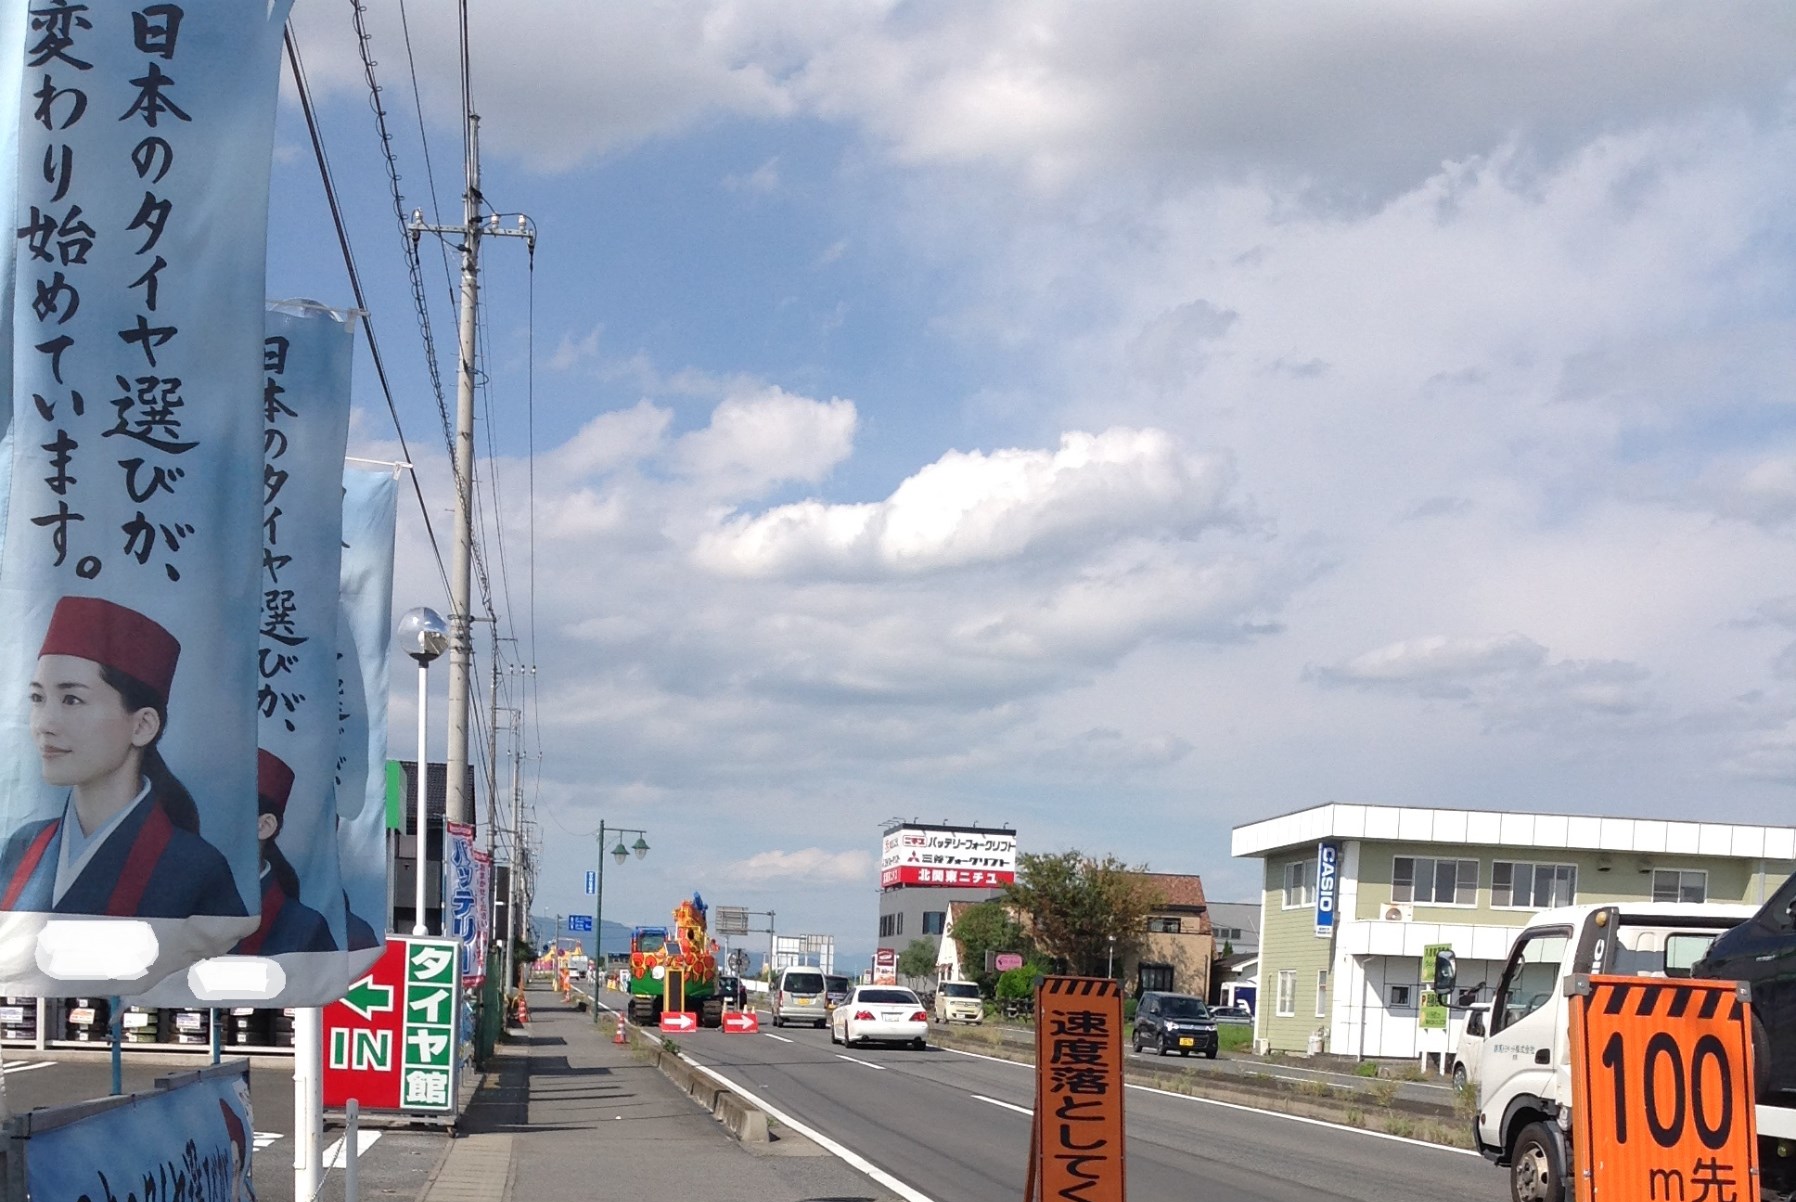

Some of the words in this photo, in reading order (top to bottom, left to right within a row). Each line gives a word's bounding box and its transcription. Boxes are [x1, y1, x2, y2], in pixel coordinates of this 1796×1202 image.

[16, 0, 103, 581] 変わり始めています。
[101, 3, 201, 582] 日本のタイヤ選びが、
[1319, 846, 1336, 912] CASIO
[329, 1026, 393, 1072] IN
[406, 946, 453, 1105] タイヤ館
[1602, 1030, 1734, 1151] 100
